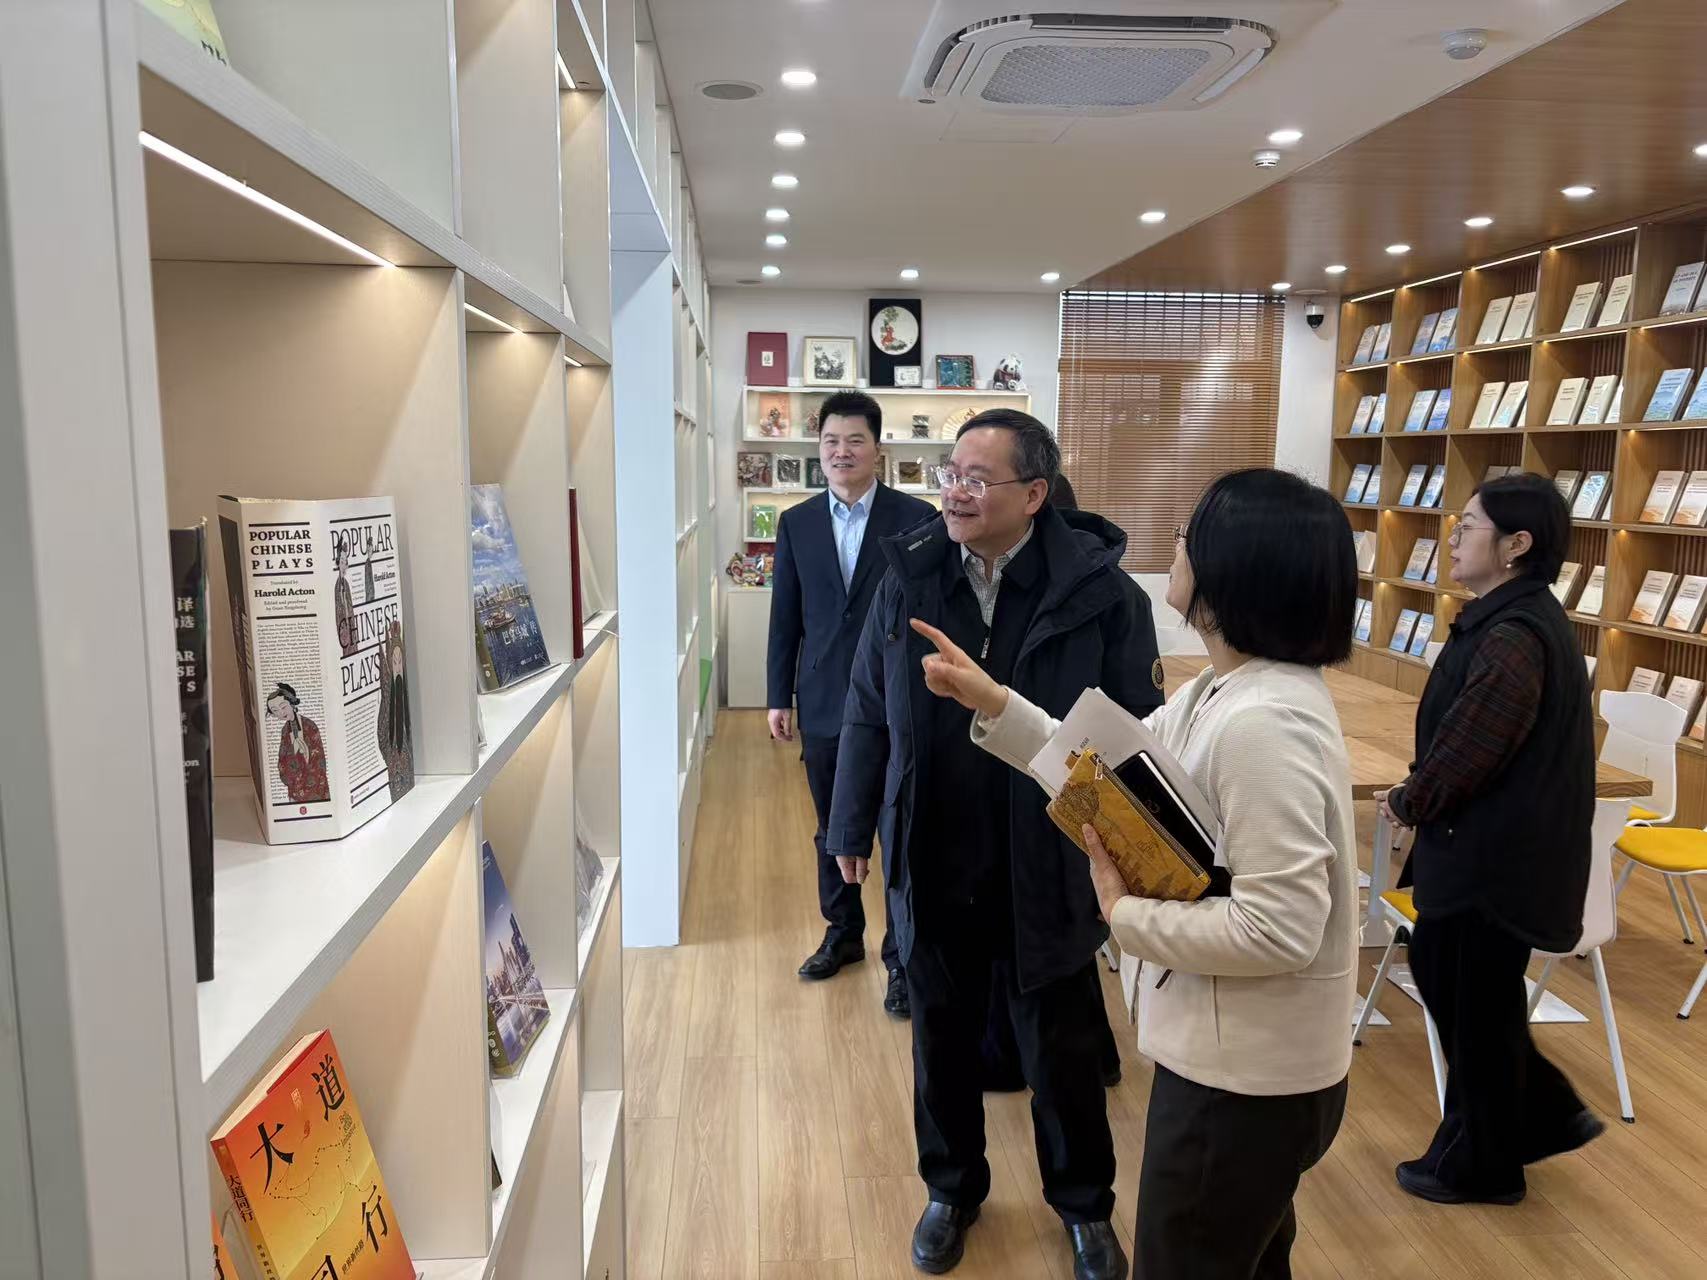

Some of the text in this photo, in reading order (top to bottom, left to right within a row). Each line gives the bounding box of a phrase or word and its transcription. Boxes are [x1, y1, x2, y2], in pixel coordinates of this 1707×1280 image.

[249, 529, 312, 541] POPULAR
[330, 523, 394, 561] POPULAR
[250, 543, 312, 555] CHINESE
[251, 558, 314, 570] PLAYS
[254, 588, 315, 598] Harold Acton
[175, 615, 195, 629] 选
[339, 602, 398, 649] CHINESE
[341, 652, 381, 697] PLAYS
